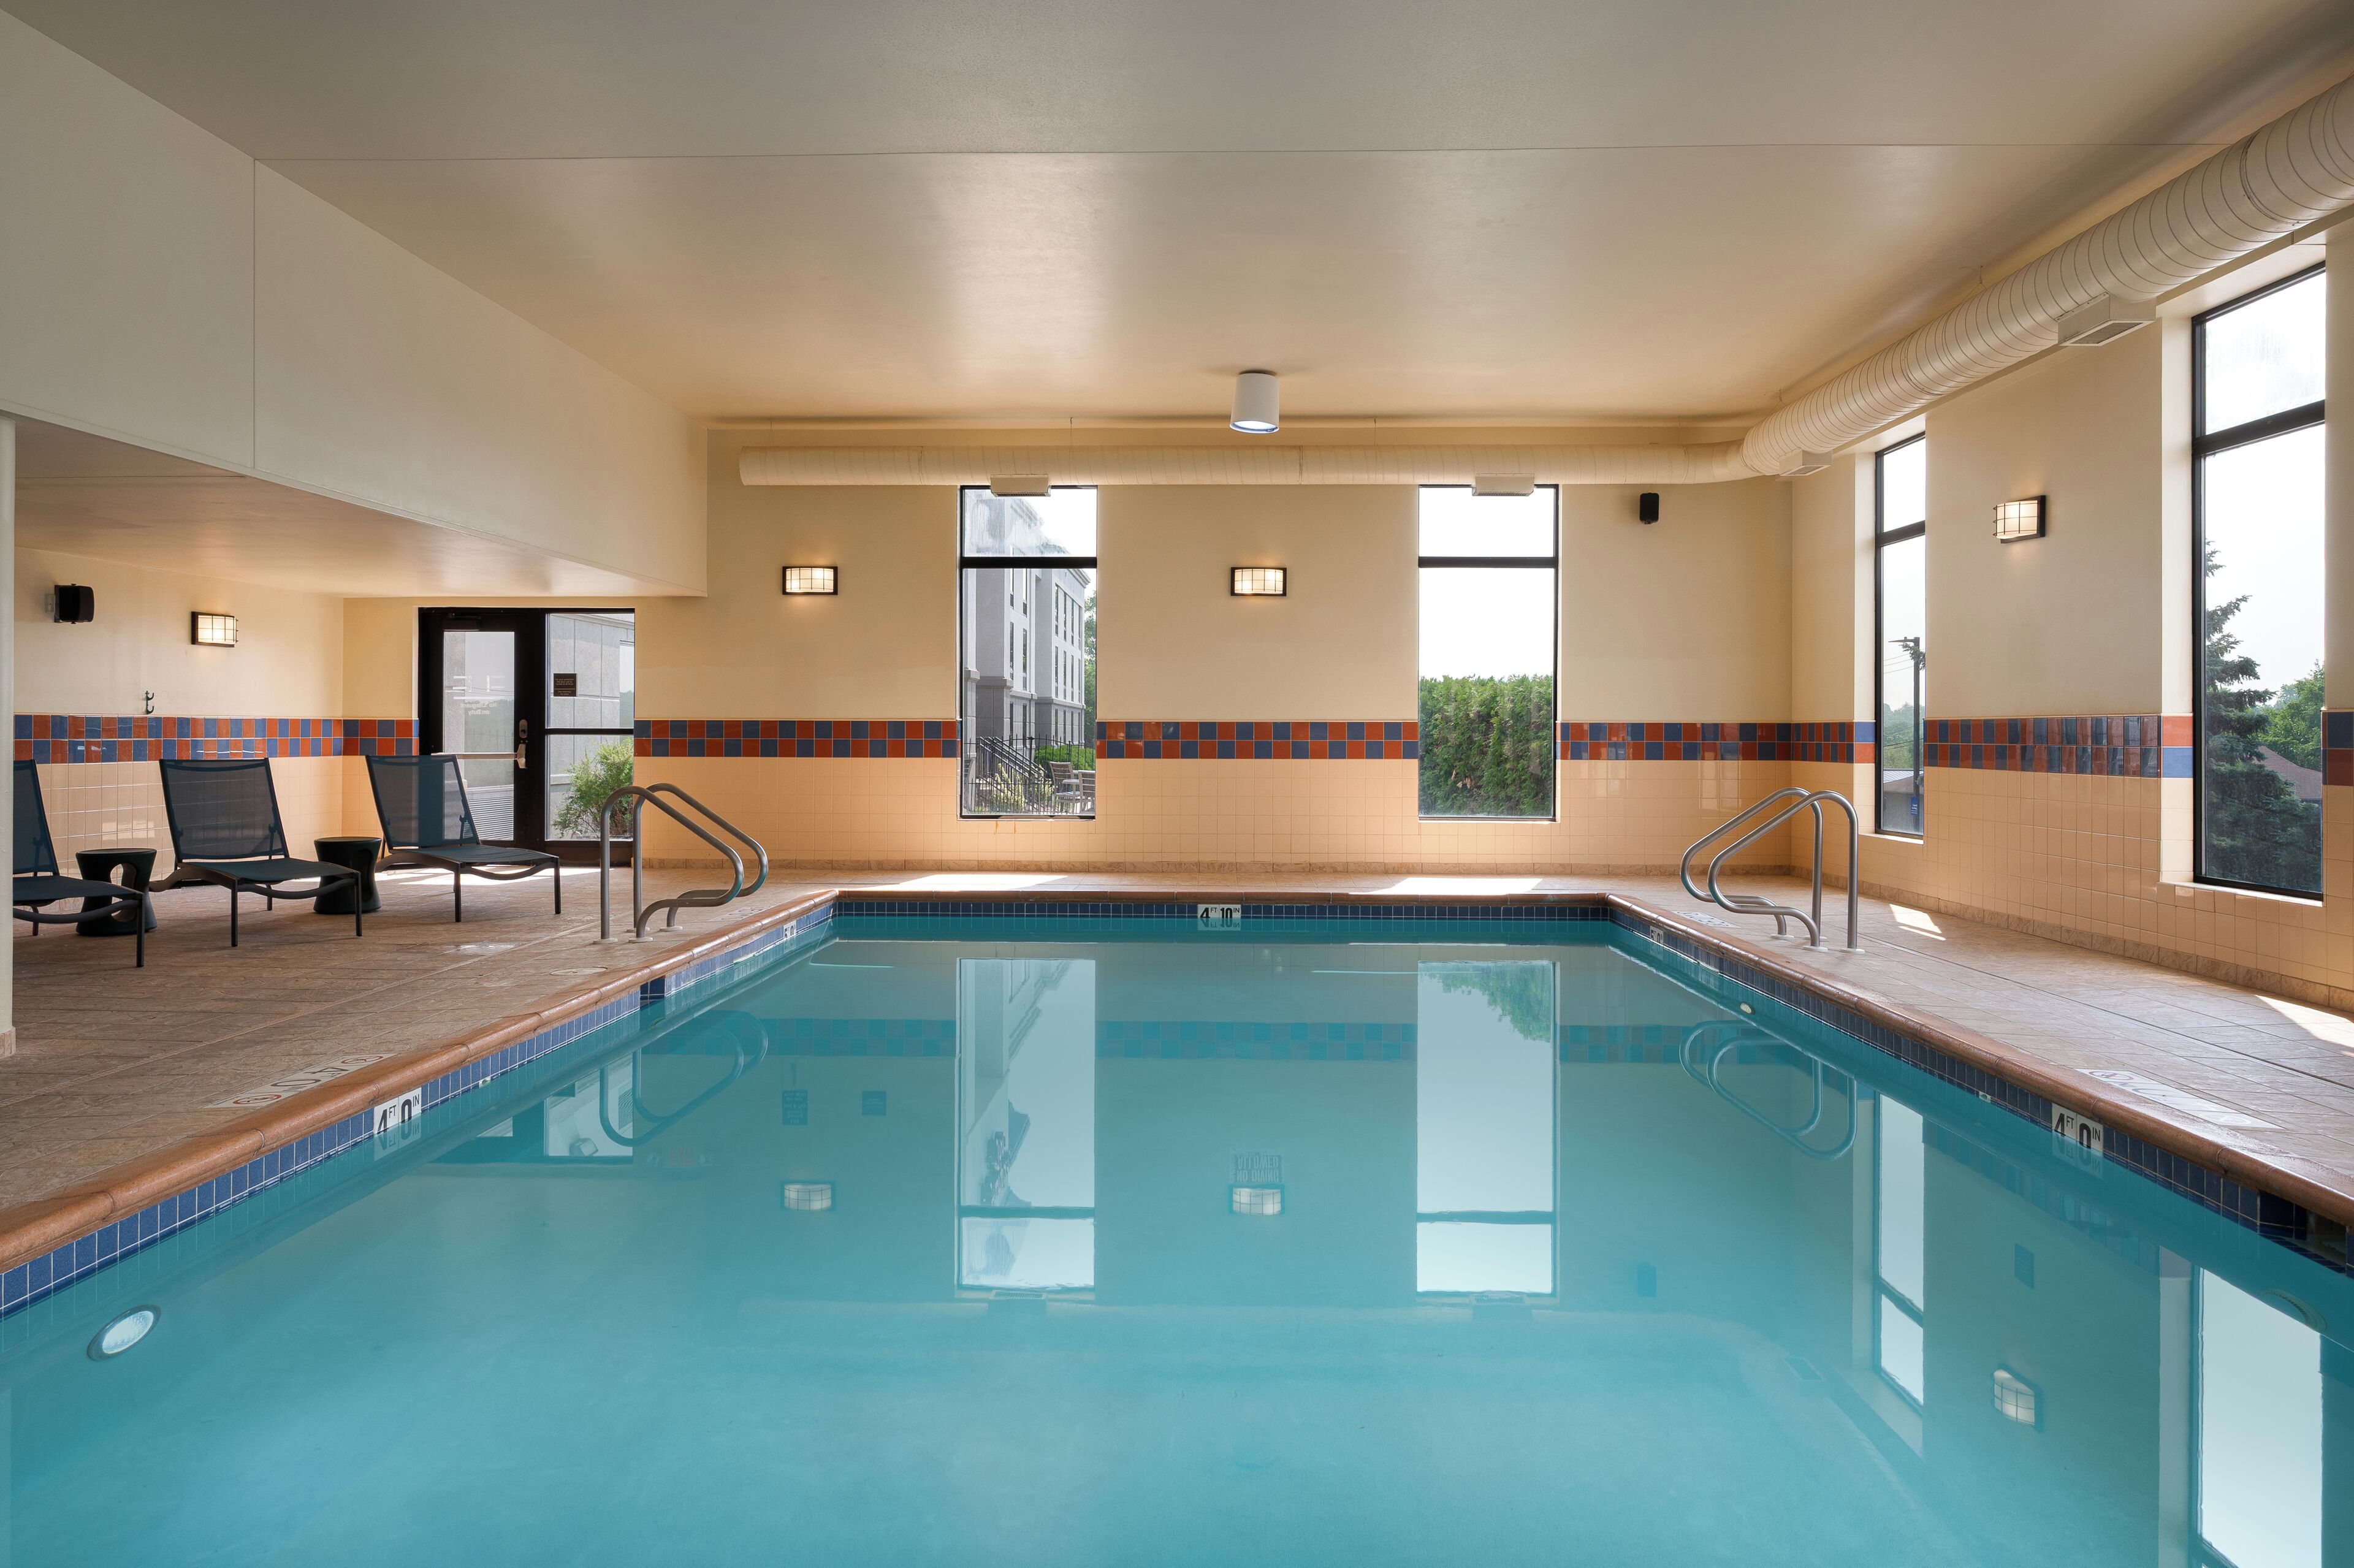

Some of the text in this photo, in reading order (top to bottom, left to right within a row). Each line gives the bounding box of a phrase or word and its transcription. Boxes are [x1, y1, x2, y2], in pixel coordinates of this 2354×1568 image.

[1200, 907, 1210, 918] 4
[1221, 907, 1233, 918] 10
[377, 1094, 419, 1134] 4 FT 0 IN
[2054, 1113, 2100, 1149] 4 FT 0 IN
